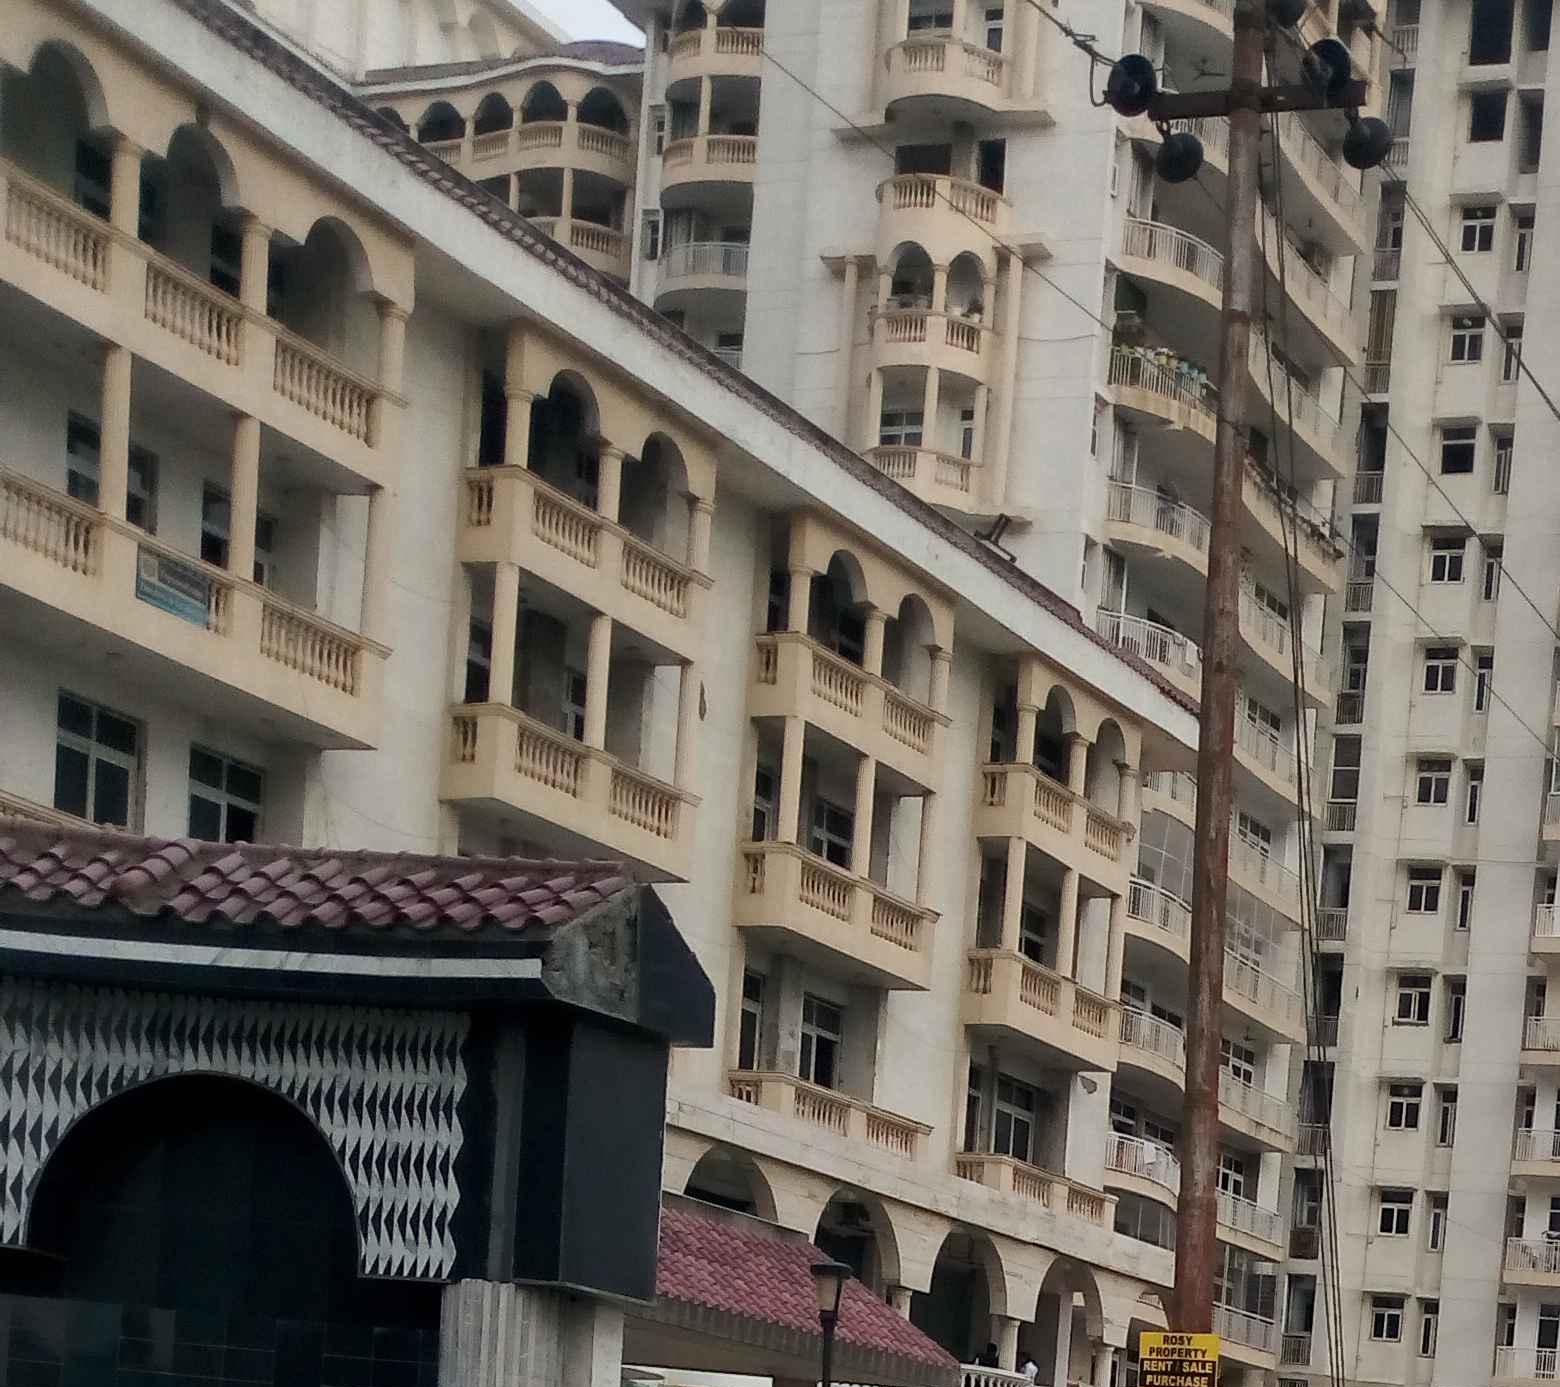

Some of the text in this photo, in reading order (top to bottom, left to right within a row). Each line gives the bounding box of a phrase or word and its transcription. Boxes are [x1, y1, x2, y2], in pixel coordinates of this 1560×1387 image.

[1163, 1335, 1192, 1346] ROSY
[1149, 1347, 1208, 1359] PROPERTY
[1143, 1360, 1173, 1371] RENT
[1182, 1361, 1213, 1373] SALE
[1146, 1374, 1209, 1387] PURCHASE
